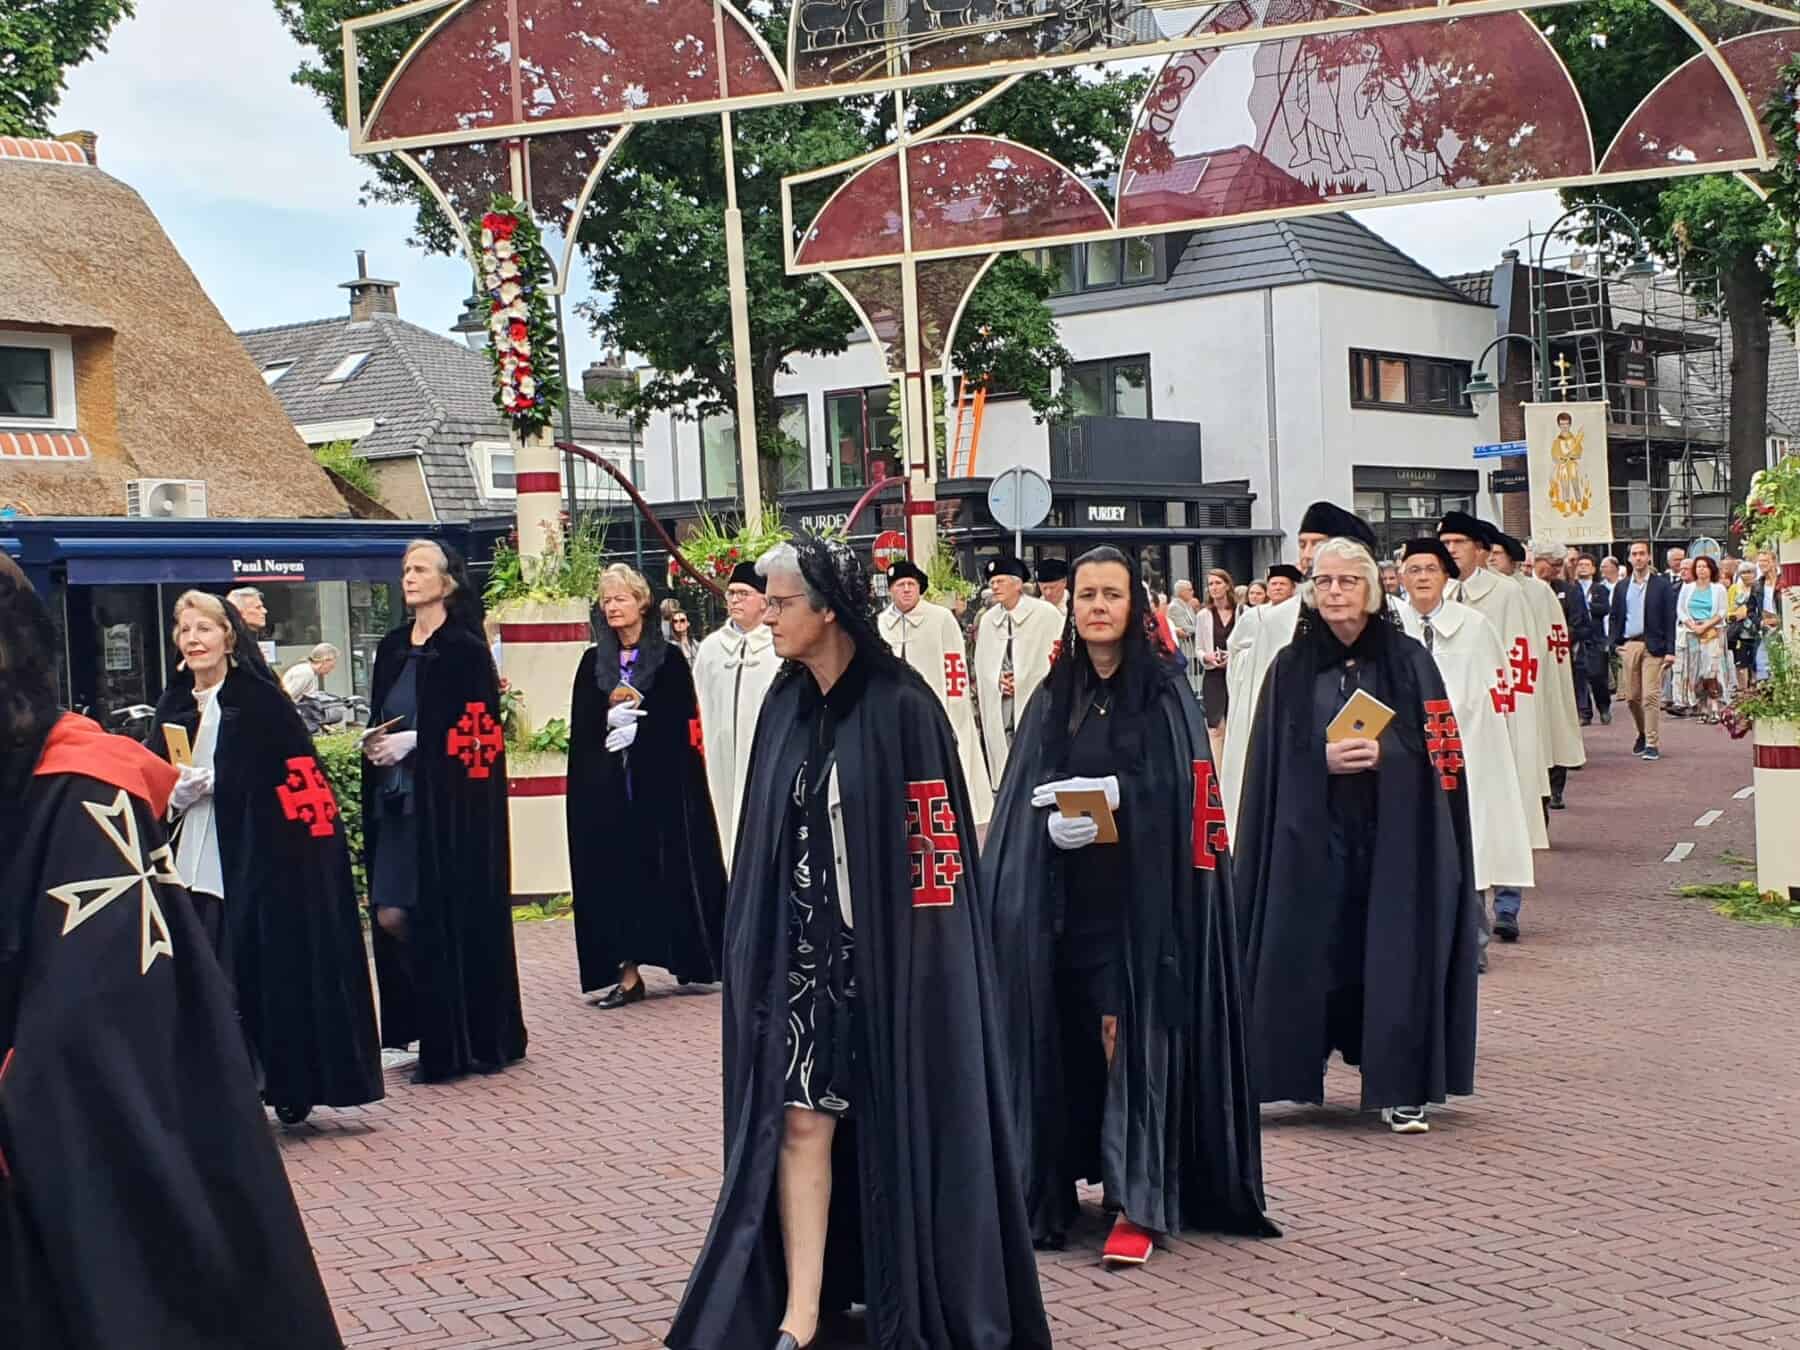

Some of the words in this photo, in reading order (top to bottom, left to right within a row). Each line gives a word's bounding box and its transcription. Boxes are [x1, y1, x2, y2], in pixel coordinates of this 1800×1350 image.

[1088, 506, 1126, 521] PURDEY
[232, 559, 262, 572] Paul
[264, 559, 304, 574] Noyen
